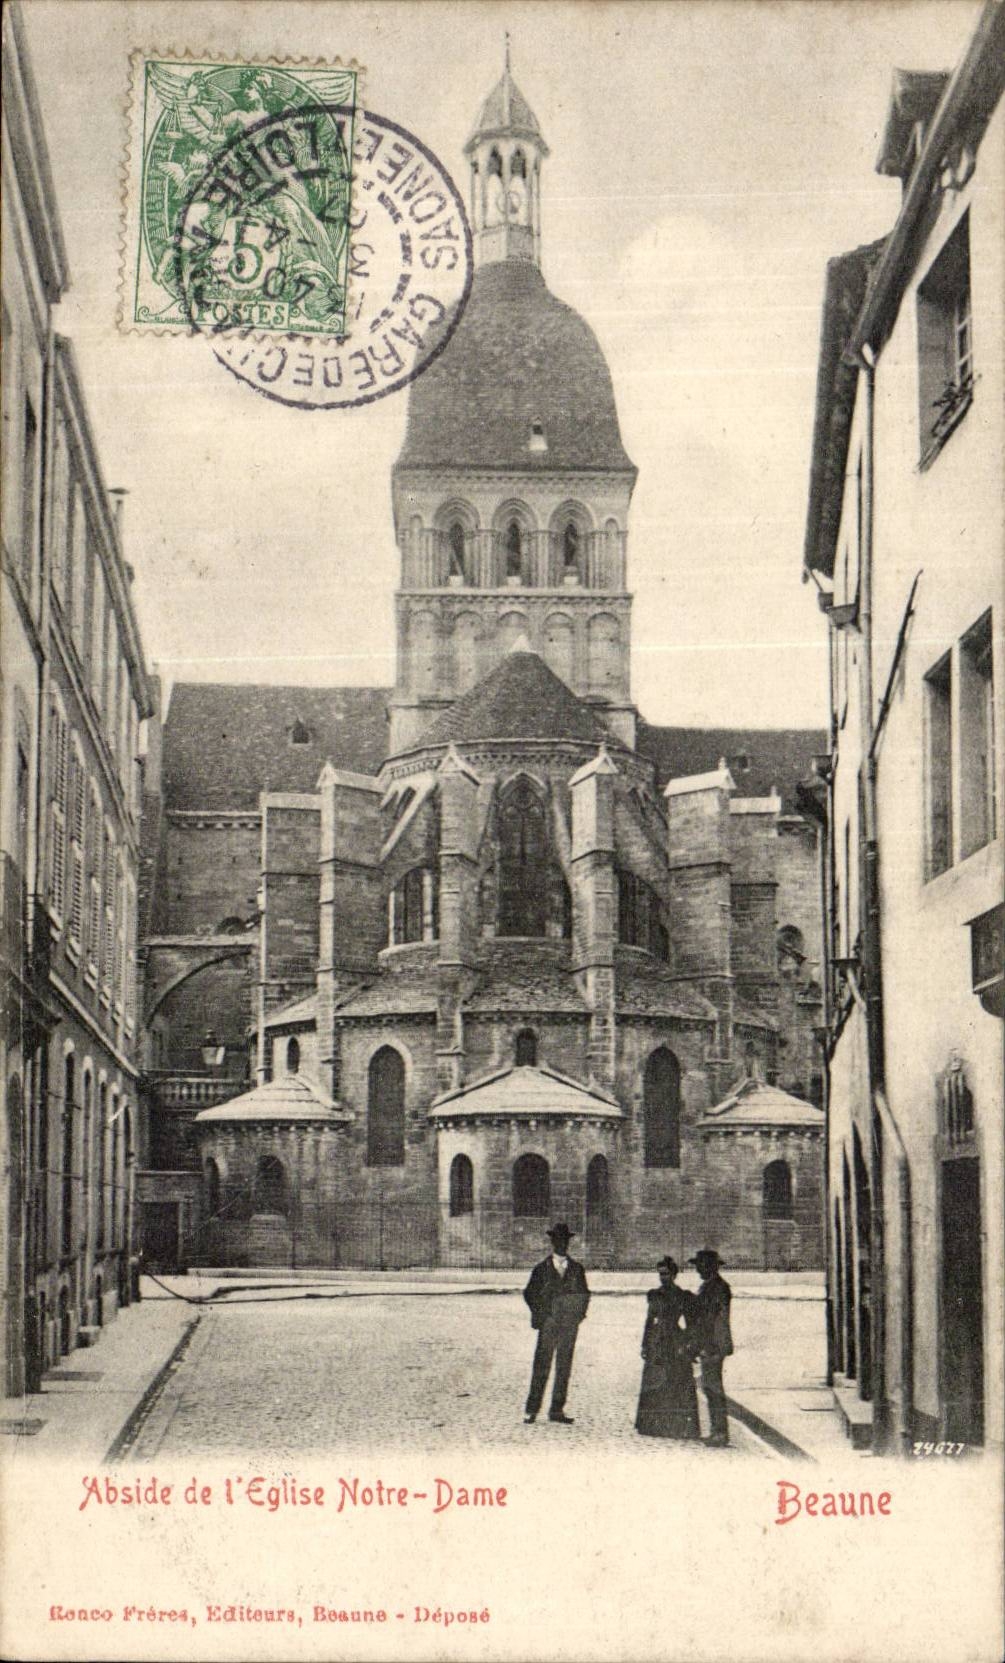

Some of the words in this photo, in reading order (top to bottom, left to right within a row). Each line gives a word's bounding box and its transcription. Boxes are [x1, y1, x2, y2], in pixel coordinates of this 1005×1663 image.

[203, 121, 318, 216] LOIRE
[376, 141, 459, 271] SAONE
[227, 220, 263, 284] 5
[195, 301, 286, 327] POSTES
